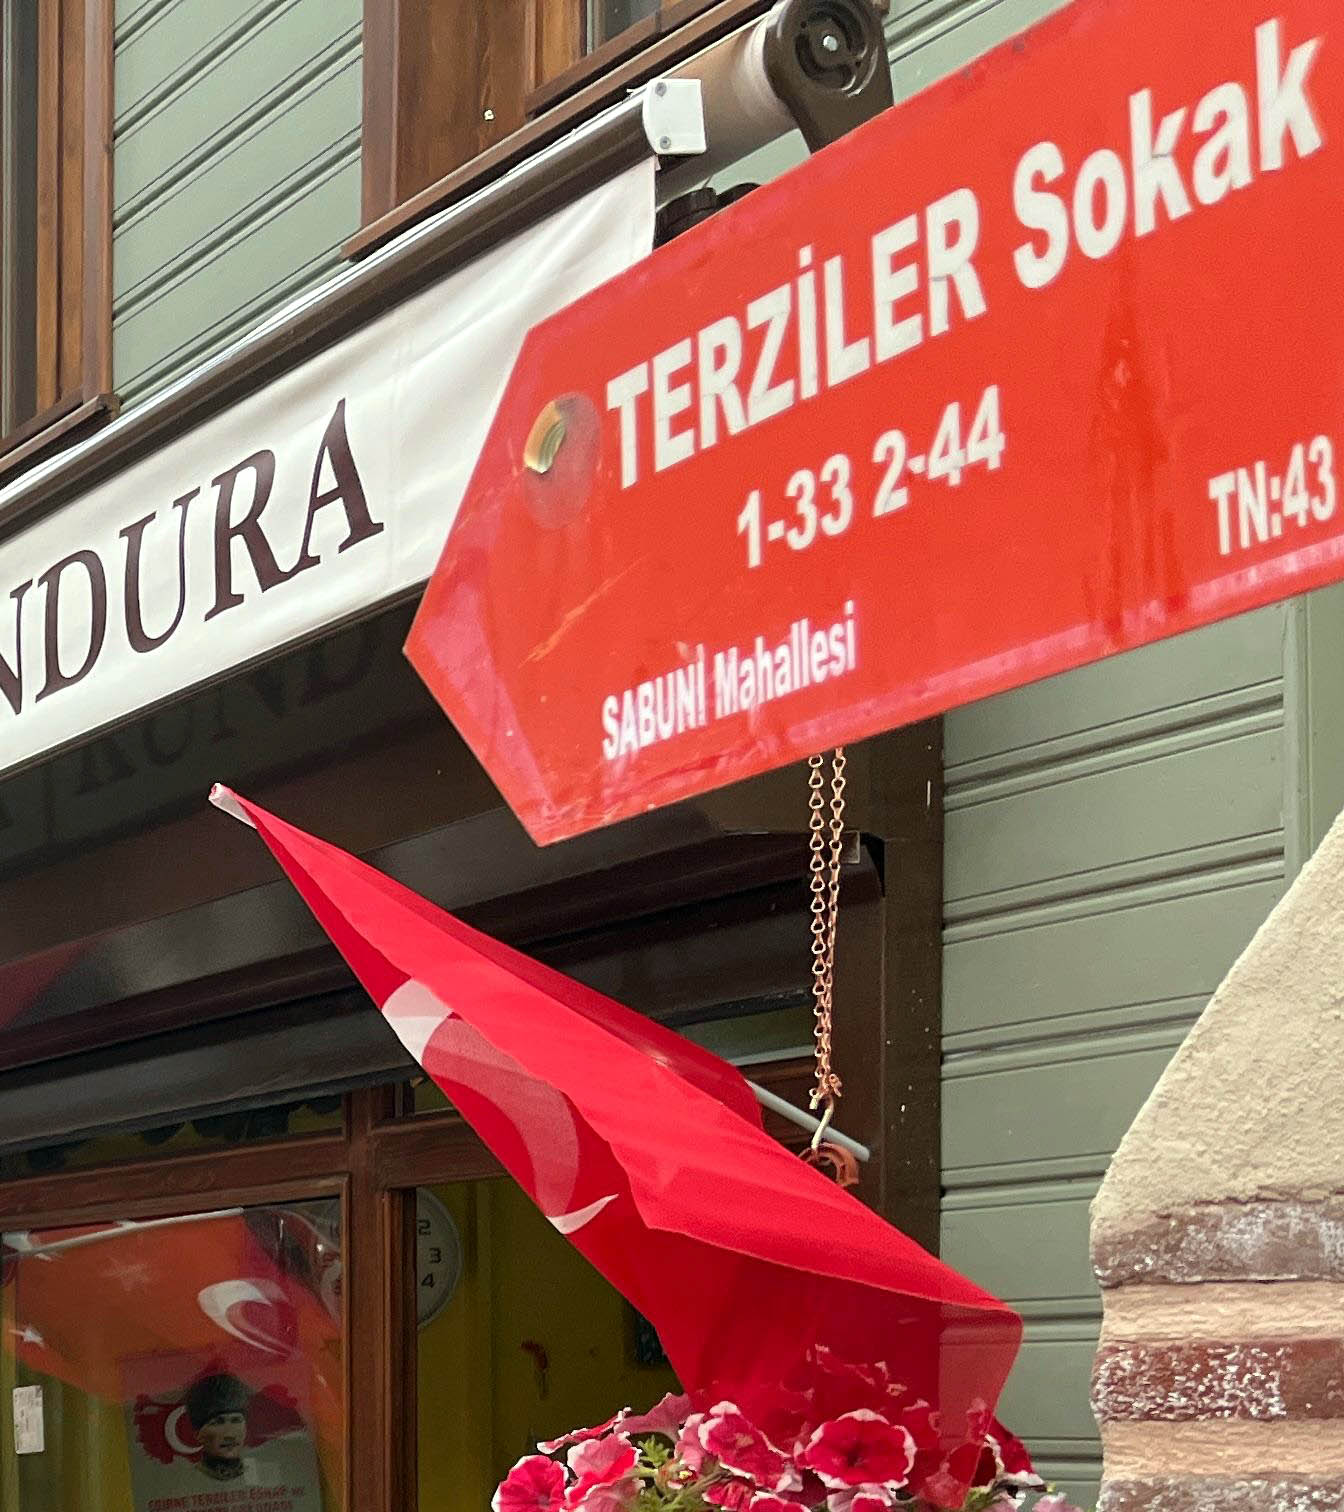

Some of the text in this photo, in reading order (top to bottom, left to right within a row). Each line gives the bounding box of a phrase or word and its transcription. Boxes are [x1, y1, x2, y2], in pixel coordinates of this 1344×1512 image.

[606, 18, 1326, 488] TERZİLER Sokak
[737, 385, 1006, 569] 1-33 2-44
[1208, 435, 1338, 556] TN:43
[602, 600, 857, 760] SABUNİ Mahallesi
